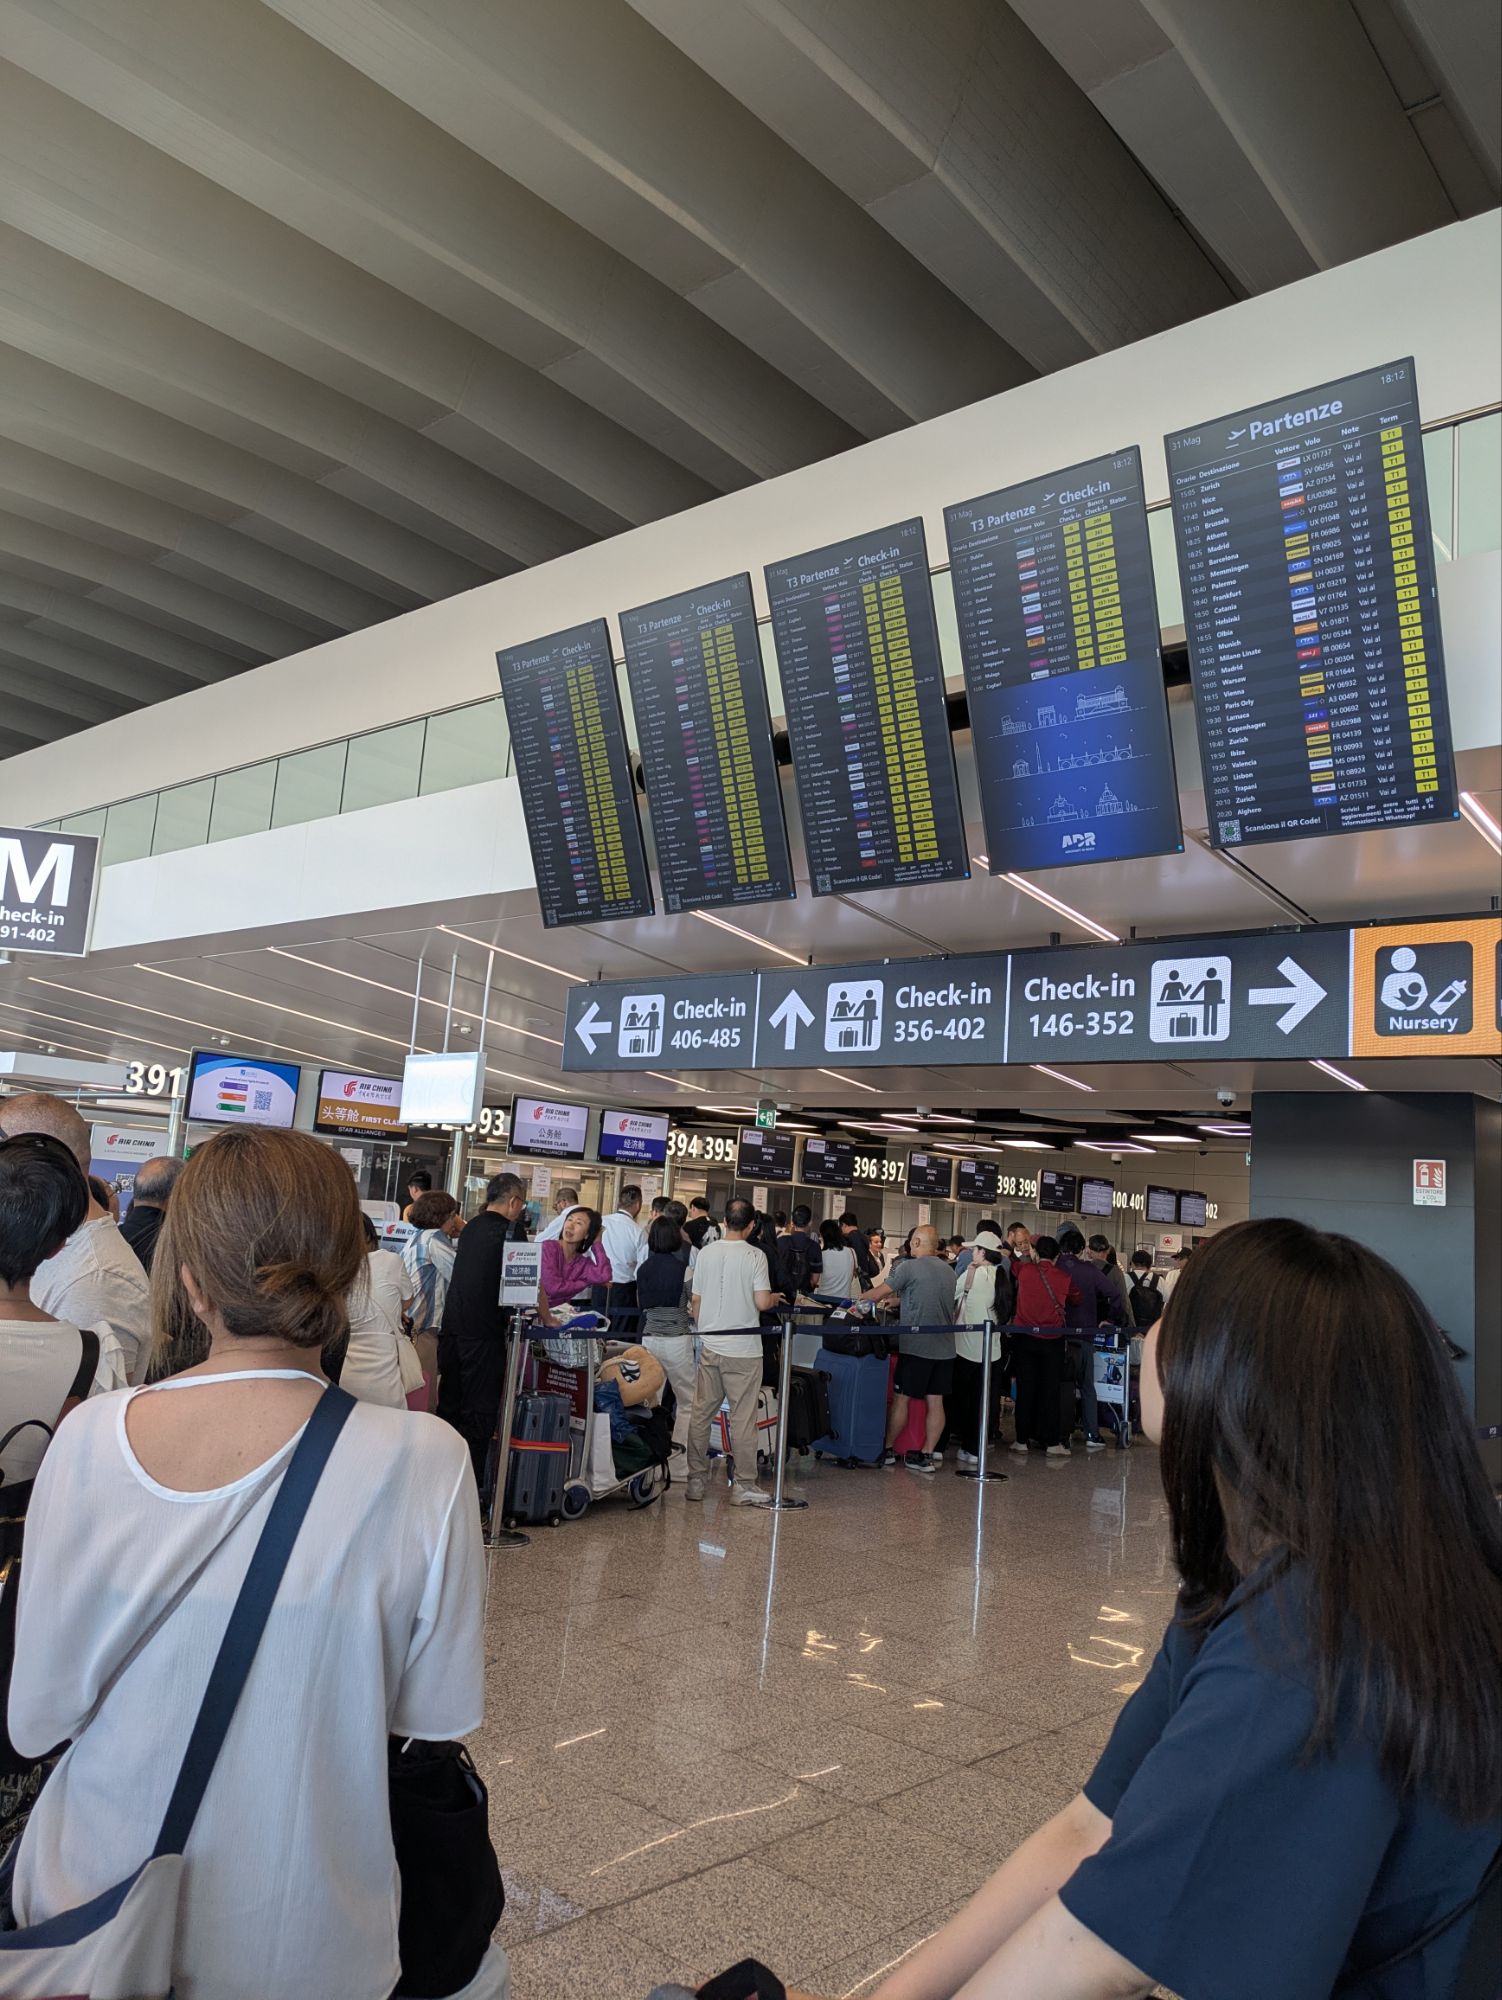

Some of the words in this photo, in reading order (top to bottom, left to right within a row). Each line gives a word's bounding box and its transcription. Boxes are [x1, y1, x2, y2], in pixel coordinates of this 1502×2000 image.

[1380, 369, 1405, 384] 18:12
[1249, 400, 1342, 440] Partenze
[1172, 440, 1181, 450] 31
[1182, 435, 1201, 446] Mag
[1175, 475, 1196, 485] Orario
[1198, 461, 1240, 478] Destinazione
[1274, 443, 1300, 455] Vettore
[1304, 436, 1320, 446] Volo
[1340, 426, 1359, 435] Note
[1379, 414, 1398, 424] Term
[1112, 456, 1132, 469] 18:12
[1200, 481, 1220, 492] Zurich
[1386, 430, 1395, 438] T1
[1202, 507, 1223, 517] Lisbon
[1389, 457, 1398, 465] T1
[970, 518, 984, 532] T3
[987, 505, 1036, 527] Partenze
[1058, 480, 1110, 504] Check-in
[1086, 498, 1104, 507] Banco
[1109, 496, 1126, 505] Status
[1201, 496, 1216, 504] Nice
[958, 509, 973, 518] Mag
[1063, 507, 1075, 515] Area
[1204, 517, 1229, 529] Brussels
[1206, 531, 1227, 541] Athens
[1207, 542, 1230, 553] Madrid
[1208, 553, 1239, 565] Barcelona
[786, 576, 798, 588] T3
[799, 566, 839, 584] Partenze
[857, 546, 899, 567] Check-in
[1209, 563, 1249, 577] Memmingen
[1211, 579, 1236, 589] Palermo
[1212, 590, 1241, 601] Frankfurt
[1213, 604, 1237, 613] Catania
[637, 623, 647, 634] T3
[648, 614, 682, 630] Partenze
[696, 598, 731, 615] Check-in
[1215, 614, 1240, 625] Helsinki
[1217, 639, 1241, 649] Munich
[511, 661, 521, 671] T3
[521, 655, 550, 669] Partenze
[561, 640, 591, 656] Check-in
[1219, 653, 1241, 661] Milano
[1241, 648, 1261, 657] Linate
[1220, 663, 1243, 673] Madrid
[1221, 676, 1246, 685] Warsaw
[1223, 689, 1245, 697] Vienna
[1325, 669, 1334, 677] FR
[1409, 654, 1418, 662] T1
[1224, 701, 1240, 709] Paris
[1240, 698, 1254, 706] Orly
[1227, 722, 1266, 733] Copenhagen
[1228, 736, 1248, 745] Zurich
[1332, 732, 1341, 740] FR
[1231, 759, 1257, 768] Valencia
[1232, 772, 1253, 780] Lisbon
[1234, 782, 1257, 792] Trapani
[1235, 795, 1255, 803] Zurich
[1237, 807, 1261, 816] Alghero
[1244, 823, 1280, 832] Scansiona
[1286, 819, 1298, 827] QR
[1299, 816, 1320, 825] Code!
[0, 837, 75, 907] M
[0, 907, 64, 926] heck-in
[0, 926, 56, 942] 91-402
[1024, 972, 1135, 1002] Check-in
[895, 982, 992, 1009] Check-in
[673, 996, 747, 1020] Check-in
[893, 1017, 985, 1042] 356-402
[1029, 1010, 1134, 1038] 146-352
[1389, 1016, 1459, 1033] Nursery
[670, 1027, 741, 1050] 406-485
[125, 1060, 182, 1099] 391
[359, 1082, 371, 1090] AIR
[371, 1084, 393, 1093] CHINA
[322, 1105, 359, 1123] 头等舱
[361, 1115, 381, 1125] FIRST
[353, 1127, 382, 1137] ALLIANCE
[132, 1139, 155, 1147] CHINA
[529, 1138, 553, 1146] BUSINESS
[666, 1131, 698, 1158] 394
[704, 1136, 734, 1162] 395
[853, 1156, 877, 1179] 396
[880, 1160, 905, 1182] 397
[996, 1175, 1016, 1196] 398
[1018, 1177, 1037, 1198] 399
[1129, 1193, 1144, 1210] 401
[395, 1227, 406, 1235] AIR
